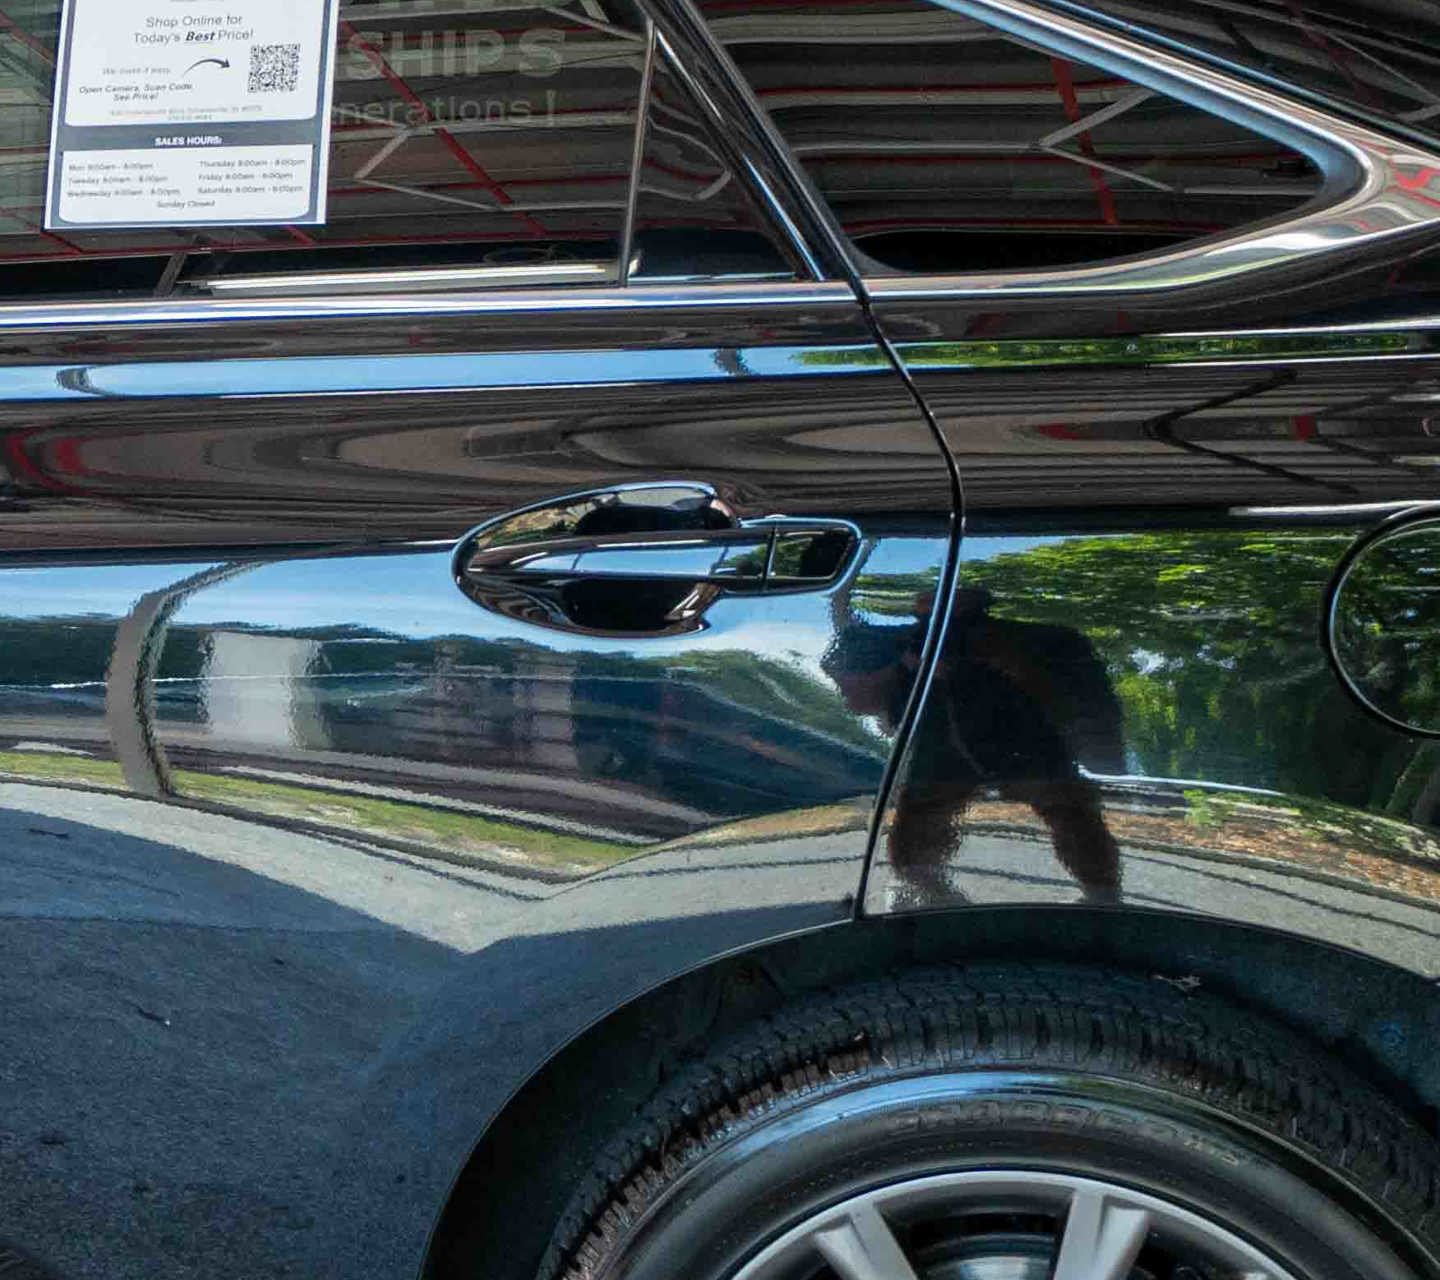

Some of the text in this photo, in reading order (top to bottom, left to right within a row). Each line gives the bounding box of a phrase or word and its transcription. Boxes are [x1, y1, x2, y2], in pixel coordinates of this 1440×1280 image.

[146, 14, 242, 30] Shop Online for
[134, 29, 254, 45] Today's Best Price!
[79, 86, 103, 94] Open
[144, 83, 166, 91] Scan
[113, 93, 130, 102] See
[155, 135, 223, 146] SALES HOURS:
[200, 159, 235, 169] Thursday
[198, 172, 223, 182] Friday
[67, 189, 112, 199] Wednesday
[197, 185, 233, 195] Saturday
[157, 199, 215, 209] Sunday Closed
